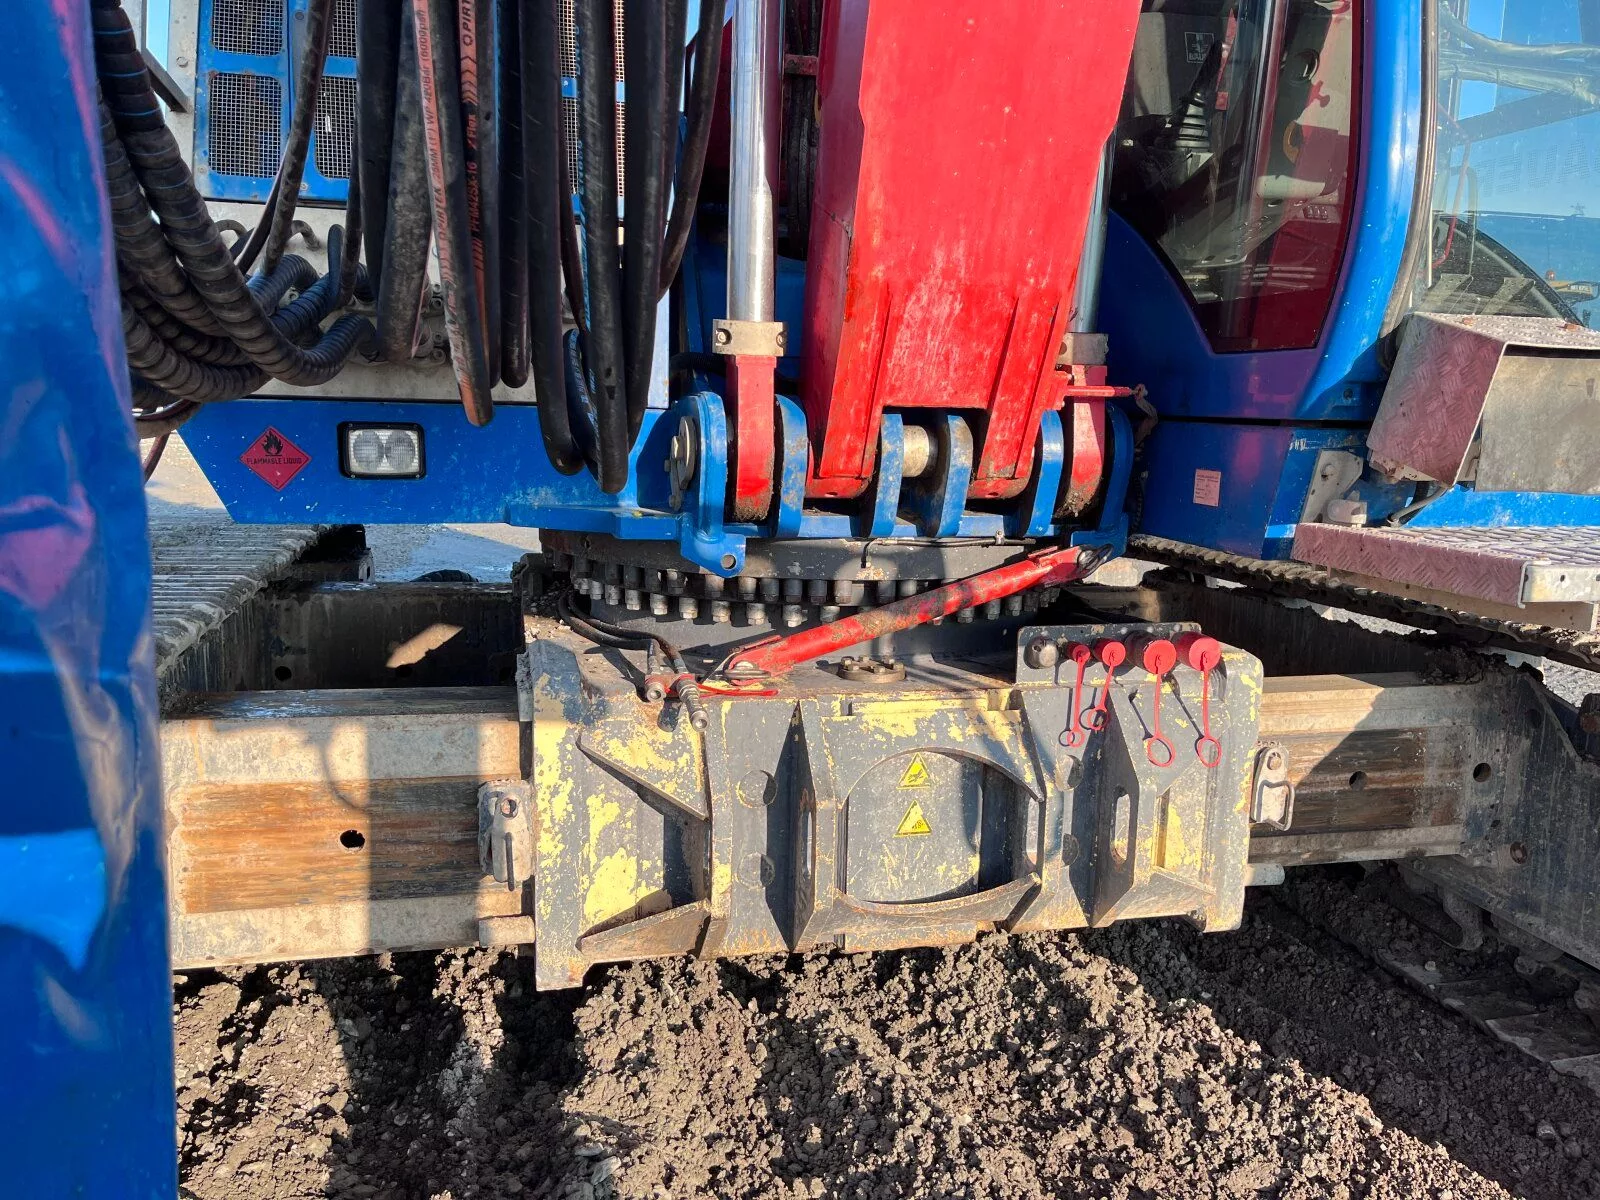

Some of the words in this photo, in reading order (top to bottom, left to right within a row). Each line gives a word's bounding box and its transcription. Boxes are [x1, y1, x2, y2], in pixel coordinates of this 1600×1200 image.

[433, 186, 446, 230] PIRTEK
[246, 457, 282, 465] FLAMMABLE
[283, 457, 302, 465] LIQUID
